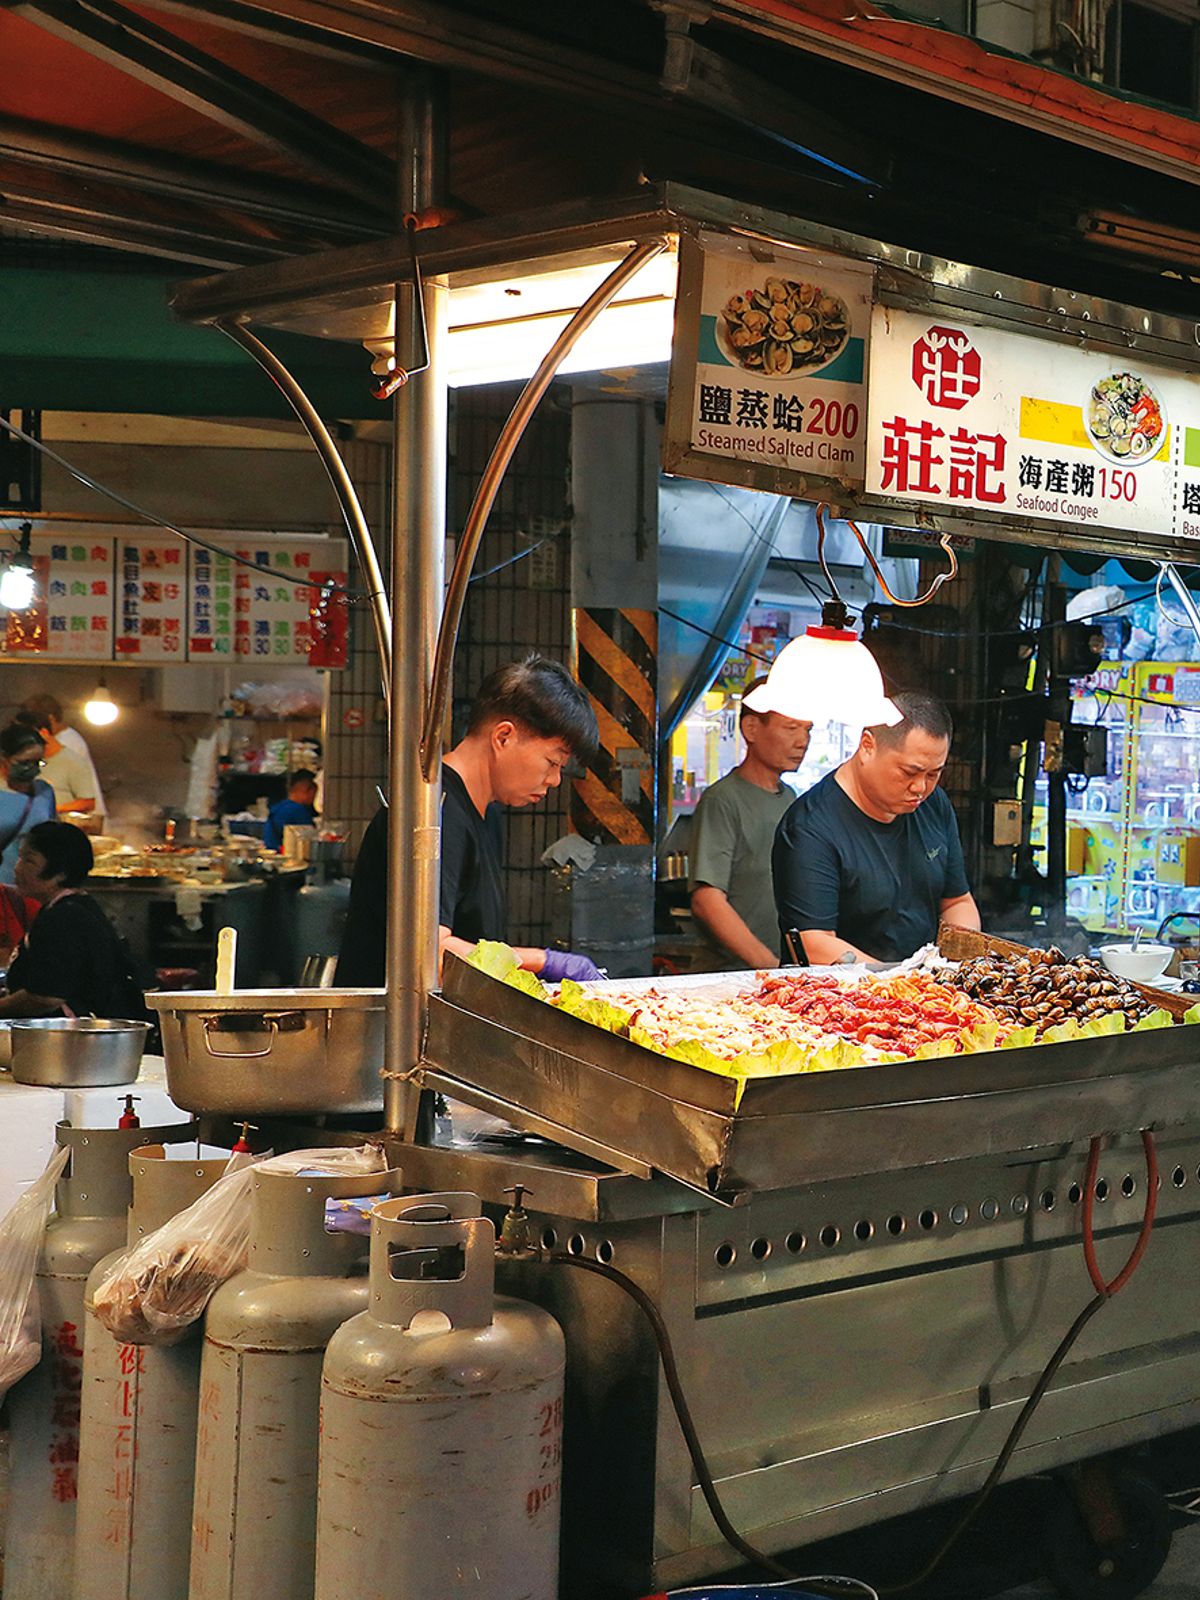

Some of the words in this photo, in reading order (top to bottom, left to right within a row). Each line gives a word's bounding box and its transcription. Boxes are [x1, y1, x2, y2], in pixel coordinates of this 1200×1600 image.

[698, 384, 805, 433] 鹽蒸蛤
[807, 398, 859, 439] 200
[697, 429, 766, 453] Steamed
[768, 436, 814, 459] Salted
[817, 442, 854, 462] Clam
[880, 415, 1008, 504] 莊記
[1018, 455, 1095, 498] 海產粥
[1098, 468, 1137, 502] 150
[1016, 494, 1058, 514] Seafood
[1060, 499, 1099, 520] Congee
